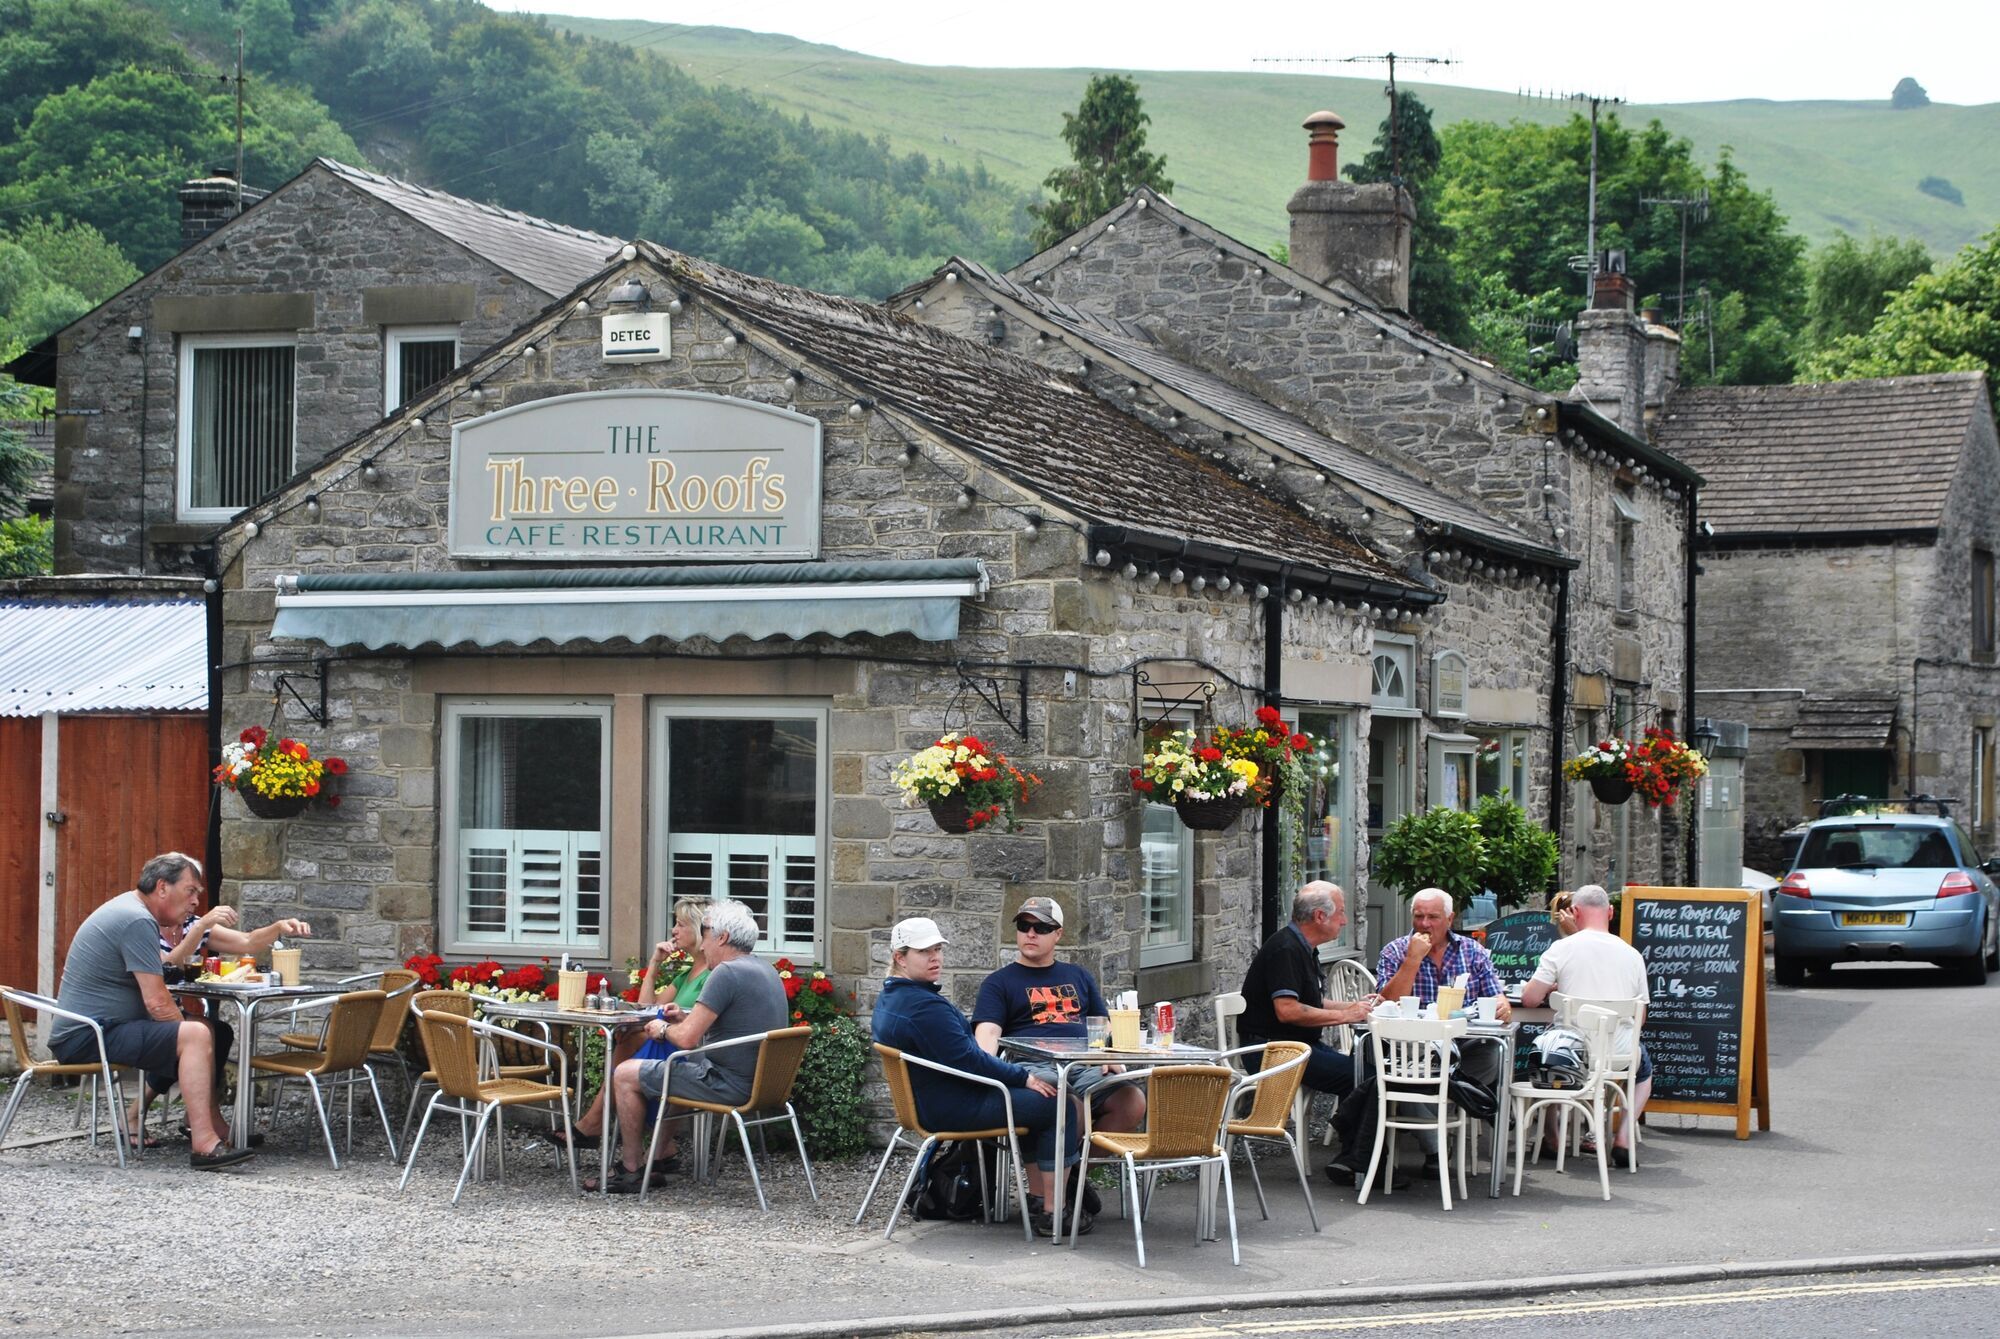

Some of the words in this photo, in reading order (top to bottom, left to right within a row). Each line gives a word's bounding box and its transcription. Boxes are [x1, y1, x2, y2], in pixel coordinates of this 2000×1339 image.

[610, 329, 651, 342] DETEC
[607, 425, 661, 454] THE
[486, 456, 619, 522] Three
[646, 456, 787, 513] Roofs
[486, 523, 565, 546] CAFÉ
[583, 525, 788, 546] RESTAURANT
[1503, 913, 1551, 926] WELCOM
[1637, 902, 1677, 920] Three
[1679, 904, 1714, 923] Roofs
[1637, 923, 1653, 937] 3
[1655, 923, 1694, 938] MEAL
[1695, 924, 1733, 939] DEAL
[1490, 931, 1523, 952] Three
[1526, 932, 1552, 953] Roof
[1491, 953, 1518, 966] COME
[1641, 945, 1652, 960] A
[1647, 962, 1690, 975] CRISPS
[1704, 960, 1739, 974] DRINK
[1639, 1030, 1657, 1039] ACON
[1658, 1030, 1692, 1040] SANDWICH
[1664, 1042, 1699, 1051] SANDWICH
[1669, 1053, 1705, 1063] SANDWICH
[1677, 1066, 1710, 1075] SANDWICH
